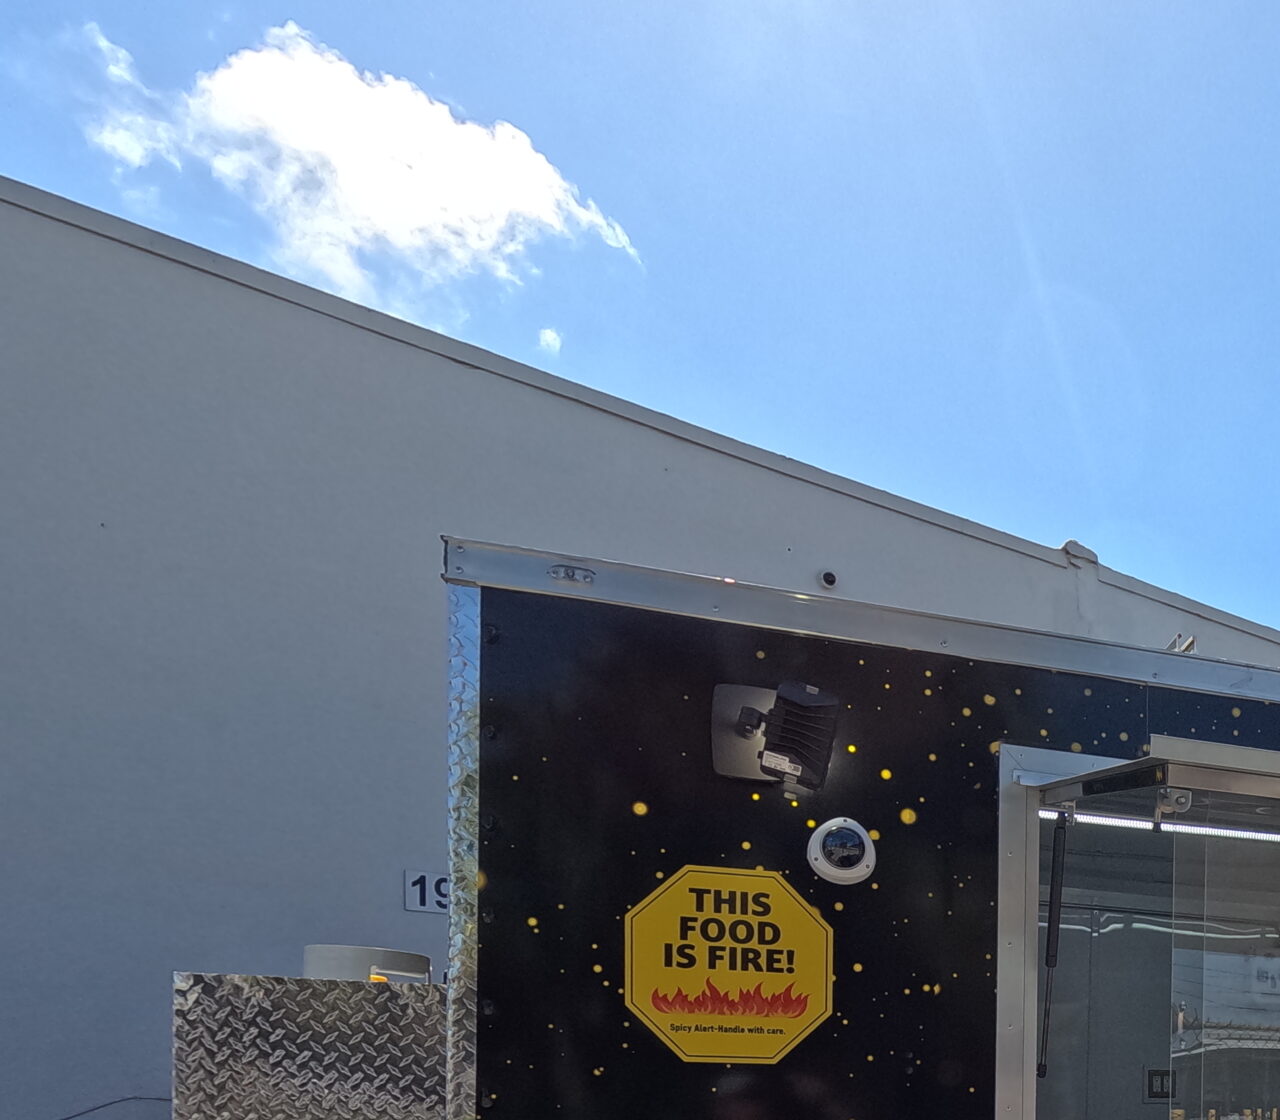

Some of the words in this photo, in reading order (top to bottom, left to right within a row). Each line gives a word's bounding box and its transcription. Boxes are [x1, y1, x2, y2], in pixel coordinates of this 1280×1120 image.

[688, 888, 772, 917] THIS
[679, 916, 782, 945] FOOD
[663, 943, 697, 969] IS
[707, 945, 796, 974] FIRE!
[669, 1023, 692, 1034] Spicy
[693, 1023, 746, 1034] Alert-Handle
[747, 1025, 765, 1035] with
[766, 1027, 787, 1035] care.
